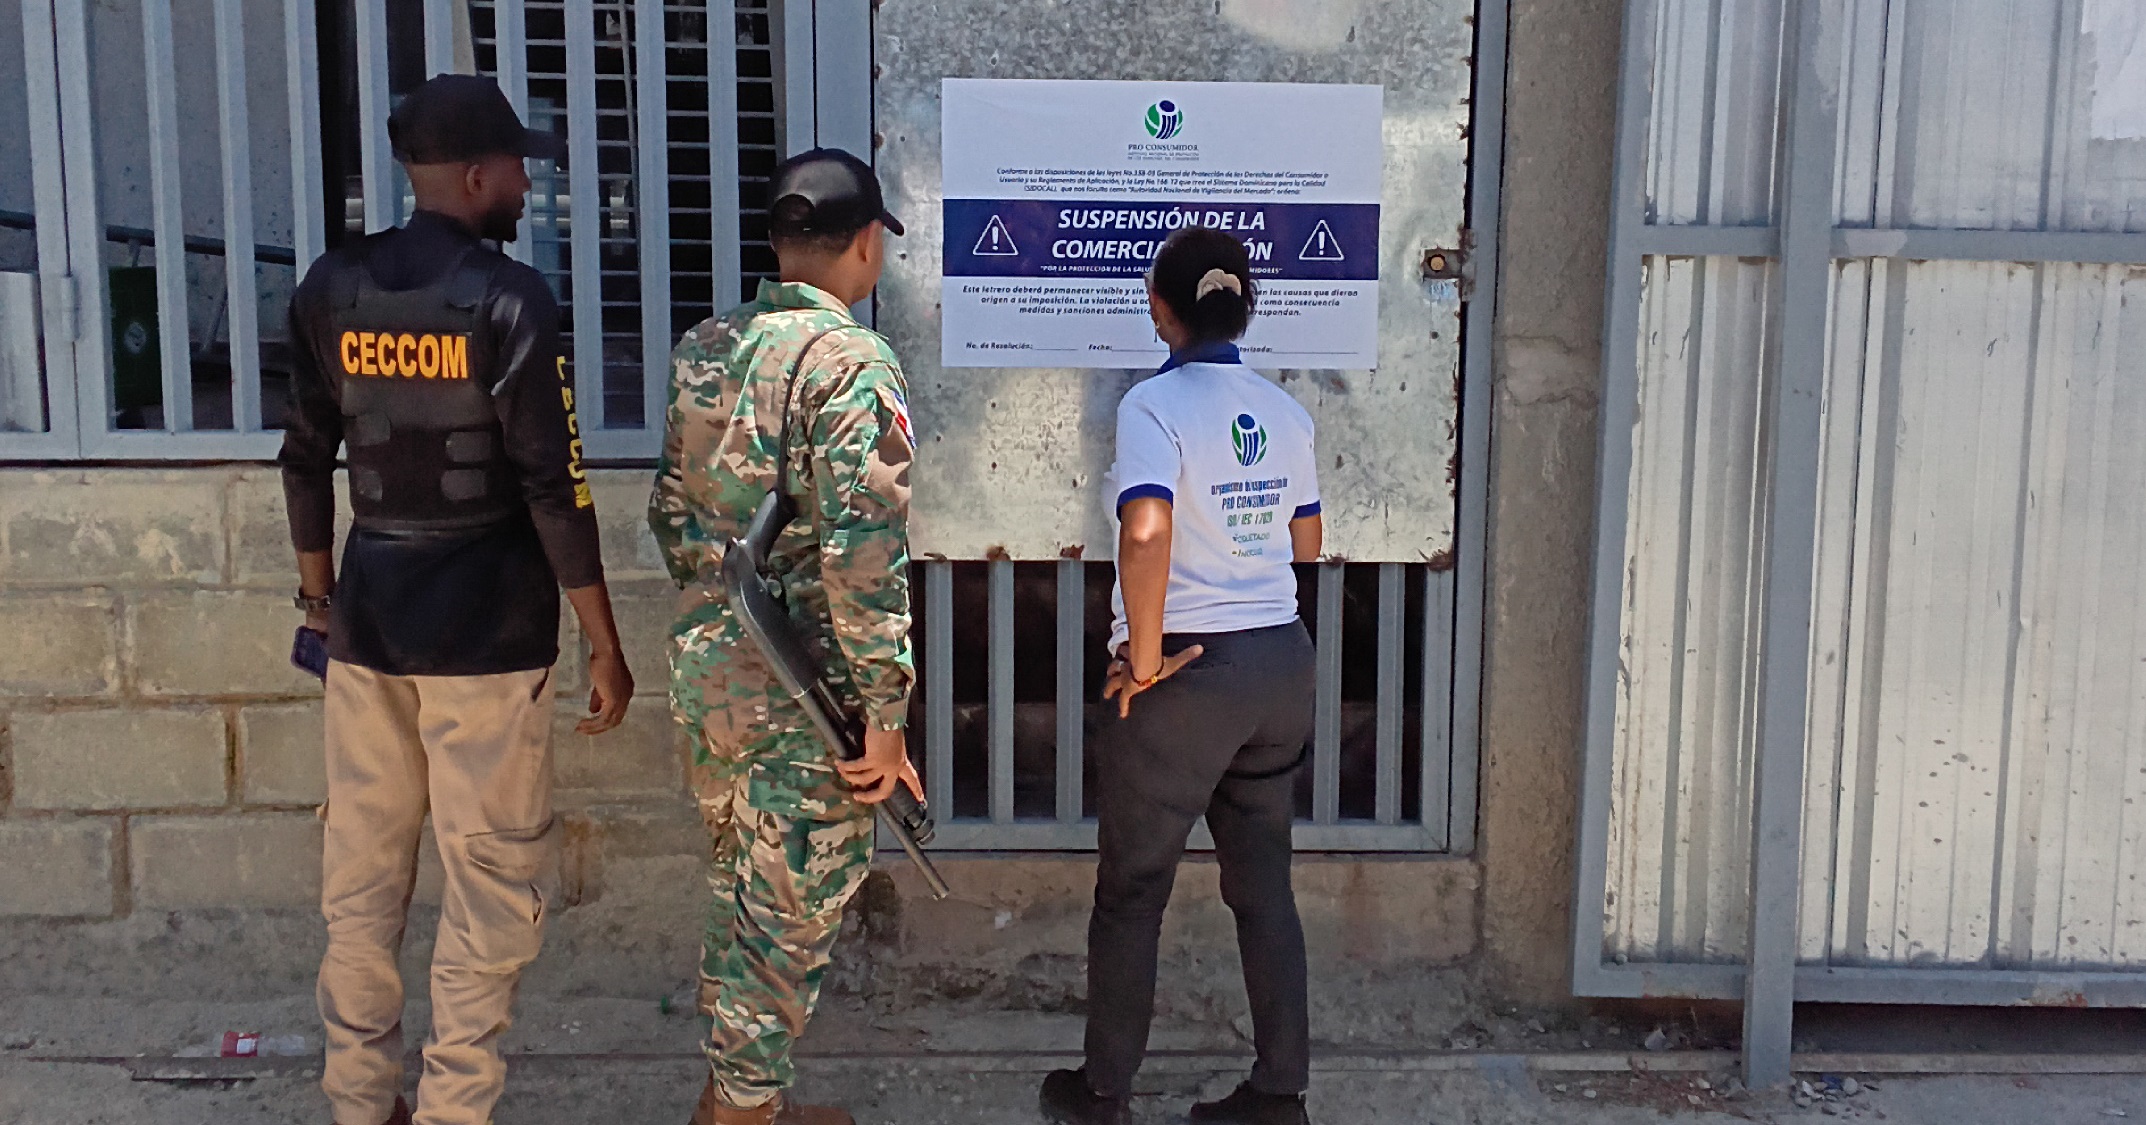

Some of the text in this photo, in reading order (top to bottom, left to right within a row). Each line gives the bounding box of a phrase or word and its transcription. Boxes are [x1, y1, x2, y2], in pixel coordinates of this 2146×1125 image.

[1045, 168, 1086, 176] disposiciones
[1191, 170, 1225, 178] Protección
[1134, 179, 1144, 187] Ley
[1213, 179, 1237, 187] Sistema
[1301, 180, 1326, 188] Calidad
[1233, 187, 1243, 195] del
[1058, 207, 1265, 231] SUSPENSIÓN DE LA
[963, 285, 980, 293] Este
[982, 285, 1011, 293] letrero
[1012, 285, 1042, 294] deberá
[1043, 286, 1094, 296] permanecer
[1132, 287, 1144, 295] sin
[1270, 288, 1282, 296] las
[1313, 290, 1329, 298] que
[1331, 289, 1358, 297] dieron
[981, 296, 1008, 305] origen
[1029, 296, 1077, 305] imposición.
[1091, 297, 1130, 305] violación
[1284, 299, 1340, 307] consecuencia
[1019, 306, 1055, 314] medidas
[1063, 307, 1105, 315] sanciones
[1106, 307, 1151, 315] administra
[340, 331, 469, 380] CECCOM
